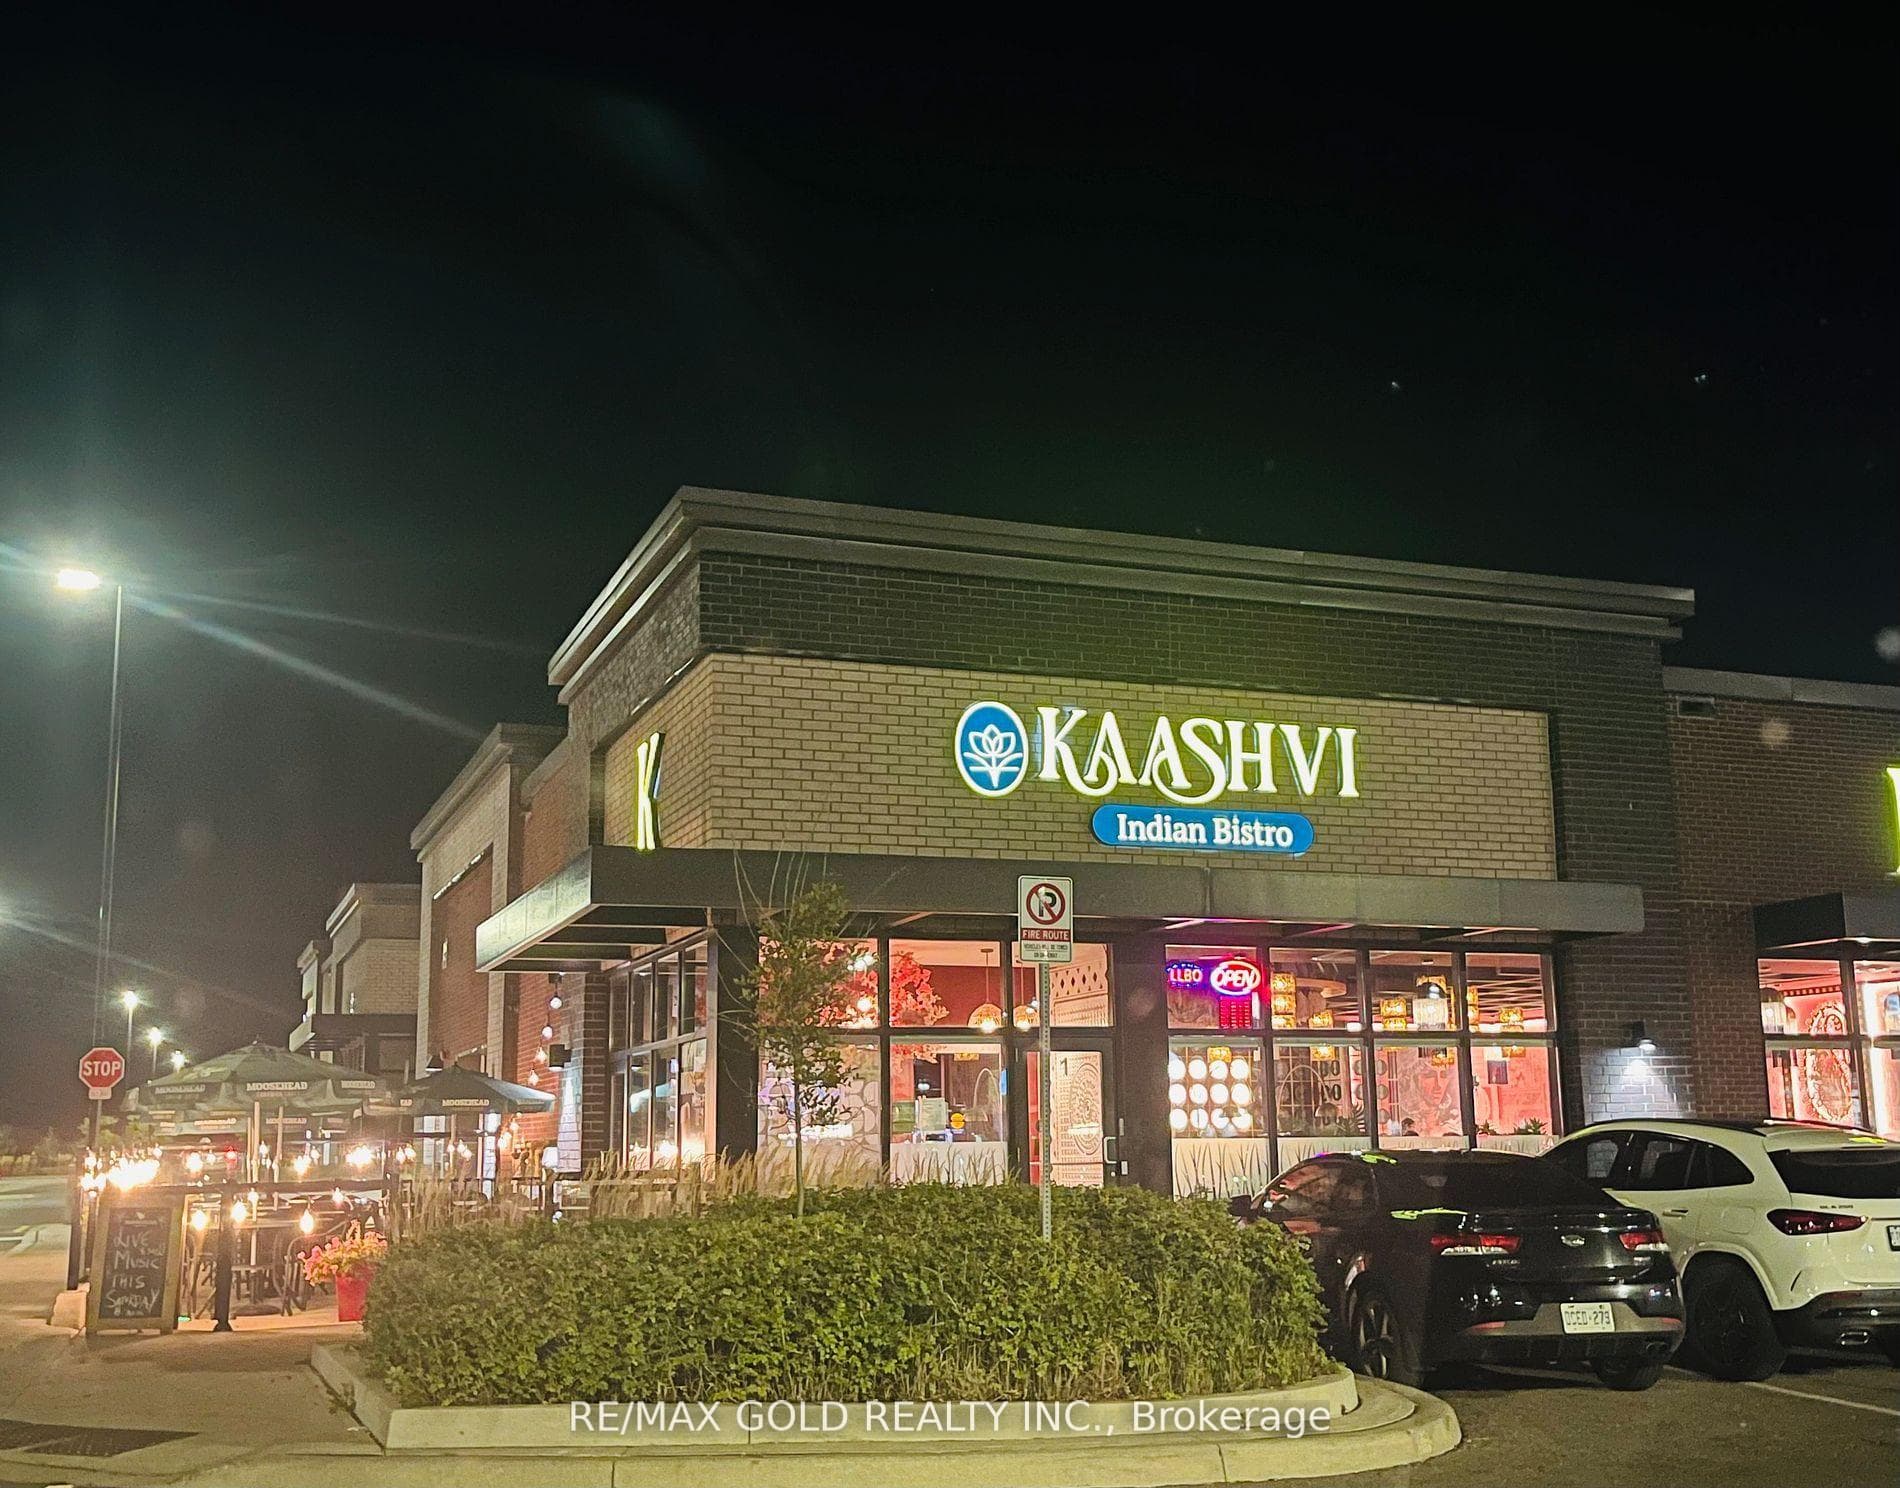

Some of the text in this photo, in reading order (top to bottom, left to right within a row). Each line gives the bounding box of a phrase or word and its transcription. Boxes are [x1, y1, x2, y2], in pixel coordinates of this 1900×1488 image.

[1036, 706, 1360, 804] KAASHVI
[637, 731, 661, 850] K
[1117, 813, 1294, 847] Indian Bistro
[1022, 929, 1069, 940] FIRE ROUTE
[1169, 968, 1203, 983] LLBO
[1215, 969, 1256, 988] OPEN
[83, 1061, 121, 1077] STOP
[1060, 1057, 1068, 1076] 1
[246, 1082, 308, 1091] MOOSEHEAD
[112, 1274, 146, 1289] THIS
